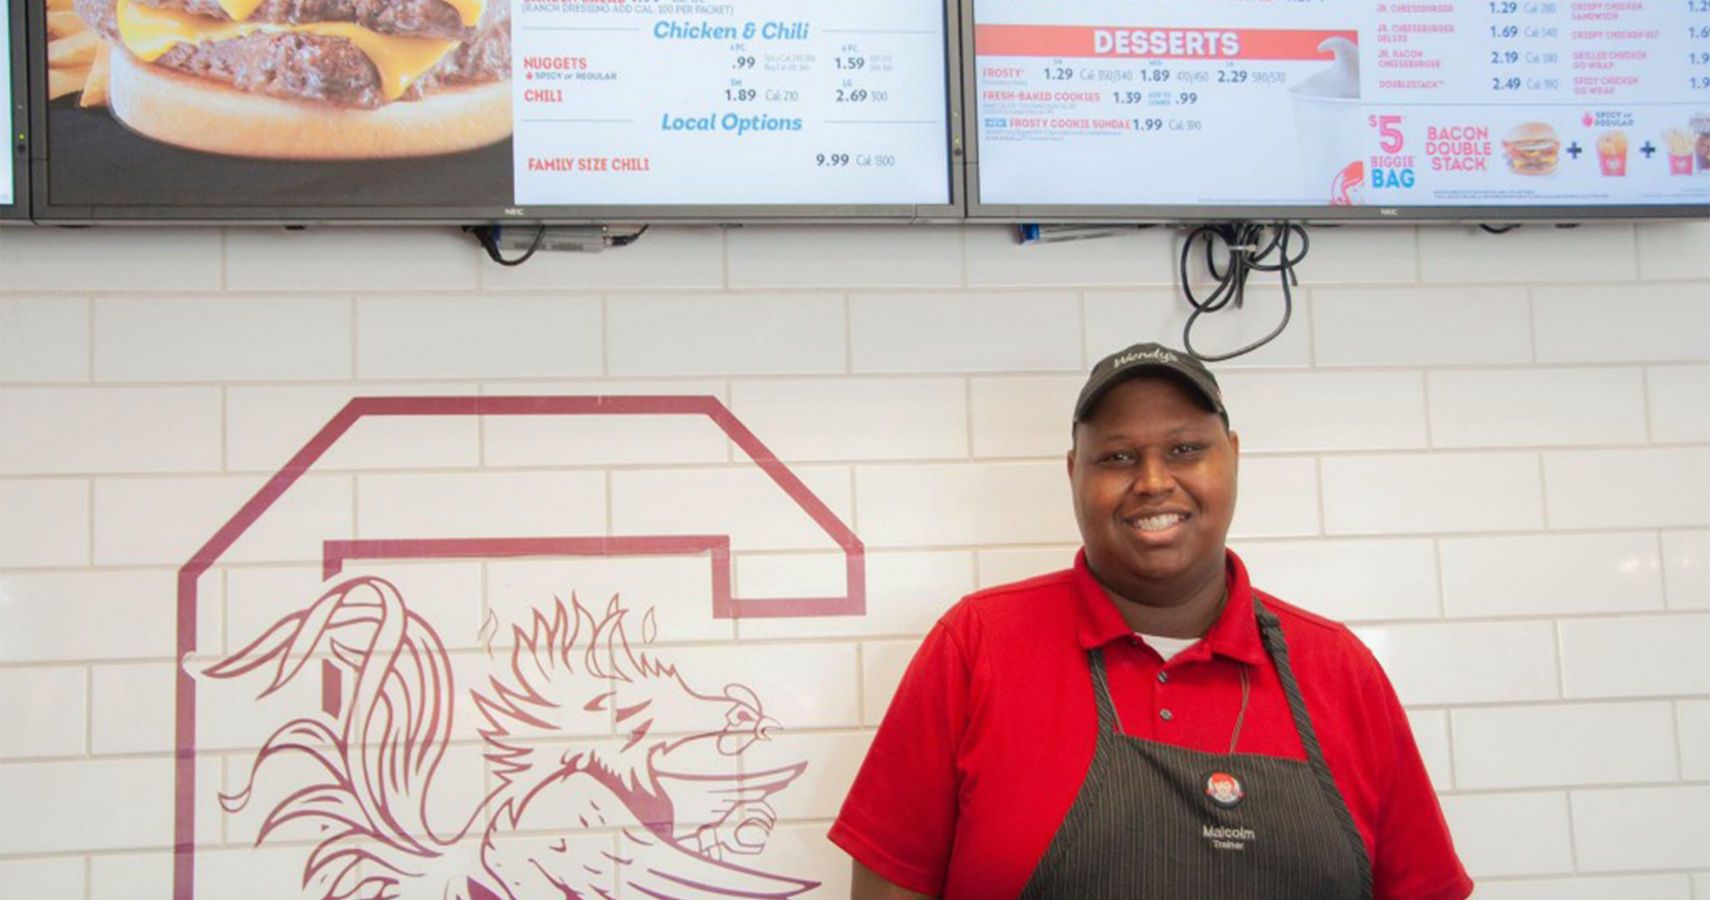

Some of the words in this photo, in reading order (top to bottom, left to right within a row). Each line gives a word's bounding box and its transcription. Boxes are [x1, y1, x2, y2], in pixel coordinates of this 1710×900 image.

[562, 4, 610, 13] DRESSING
[613, 4, 634, 13] ADD
[676, 5, 693, 14] PER
[1390, 4, 1454, 13] CHEESEBURGER
[1490, 2, 1518, 13] 1.29
[1604, 3, 1643, 11] CHICKEN
[653, 20, 737, 40] Chicken
[742, 21, 757, 40] &
[762, 22, 810, 40] Chili
[1391, 24, 1454, 32] CHEESEBURGER
[1490, 25, 1518, 38] 1.69
[1093, 29, 1240, 57] DESSERTS
[524, 57, 588, 70] NUGGETS
[732, 56, 756, 70] .99
[834, 57, 865, 70] 1.59
[1491, 51, 1519, 64] 2.19
[535, 72, 562, 80] SPICY
[1044, 68, 1073, 80] 1.29
[1140, 68, 1170, 82] 1.89
[1217, 70, 1248, 83] 2.29
[1492, 77, 1521, 90] 2.49
[524, 90, 563, 102] CHILI
[725, 89, 757, 102] 1.89
[836, 89, 868, 103] 2.69
[982, 91, 1052, 102] FRESH-BAKED
[1054, 92, 1100, 102] COOKIES
[1113, 92, 1142, 104] 1.39
[1175, 93, 1198, 105] .99
[661, 113, 717, 130] Local
[721, 113, 803, 135] Options
[1009, 118, 1048, 129] FROSTY
[1050, 118, 1090, 129] COOKIE
[1092, 119, 1131, 129] SUNDAE
[1132, 119, 1163, 131] 1.99
[1594, 119, 1634, 127] REGULAR
[1427, 126, 1489, 140] BACON
[1426, 142, 1492, 156] DOUBLE
[528, 158, 574, 171] FAMILY
[577, 158, 607, 171] SIZE
[611, 158, 650, 171] CHILI
[815, 154, 850, 166] 9.99
[1370, 156, 1415, 167] BIGGIE
[1431, 157, 1487, 171] STACK
[1371, 168, 1416, 189] BAG
[1113, 348, 1179, 369] Wendy's
[1202, 825, 1256, 840] Malcolm
[1212, 839, 1245, 850] Trainer
